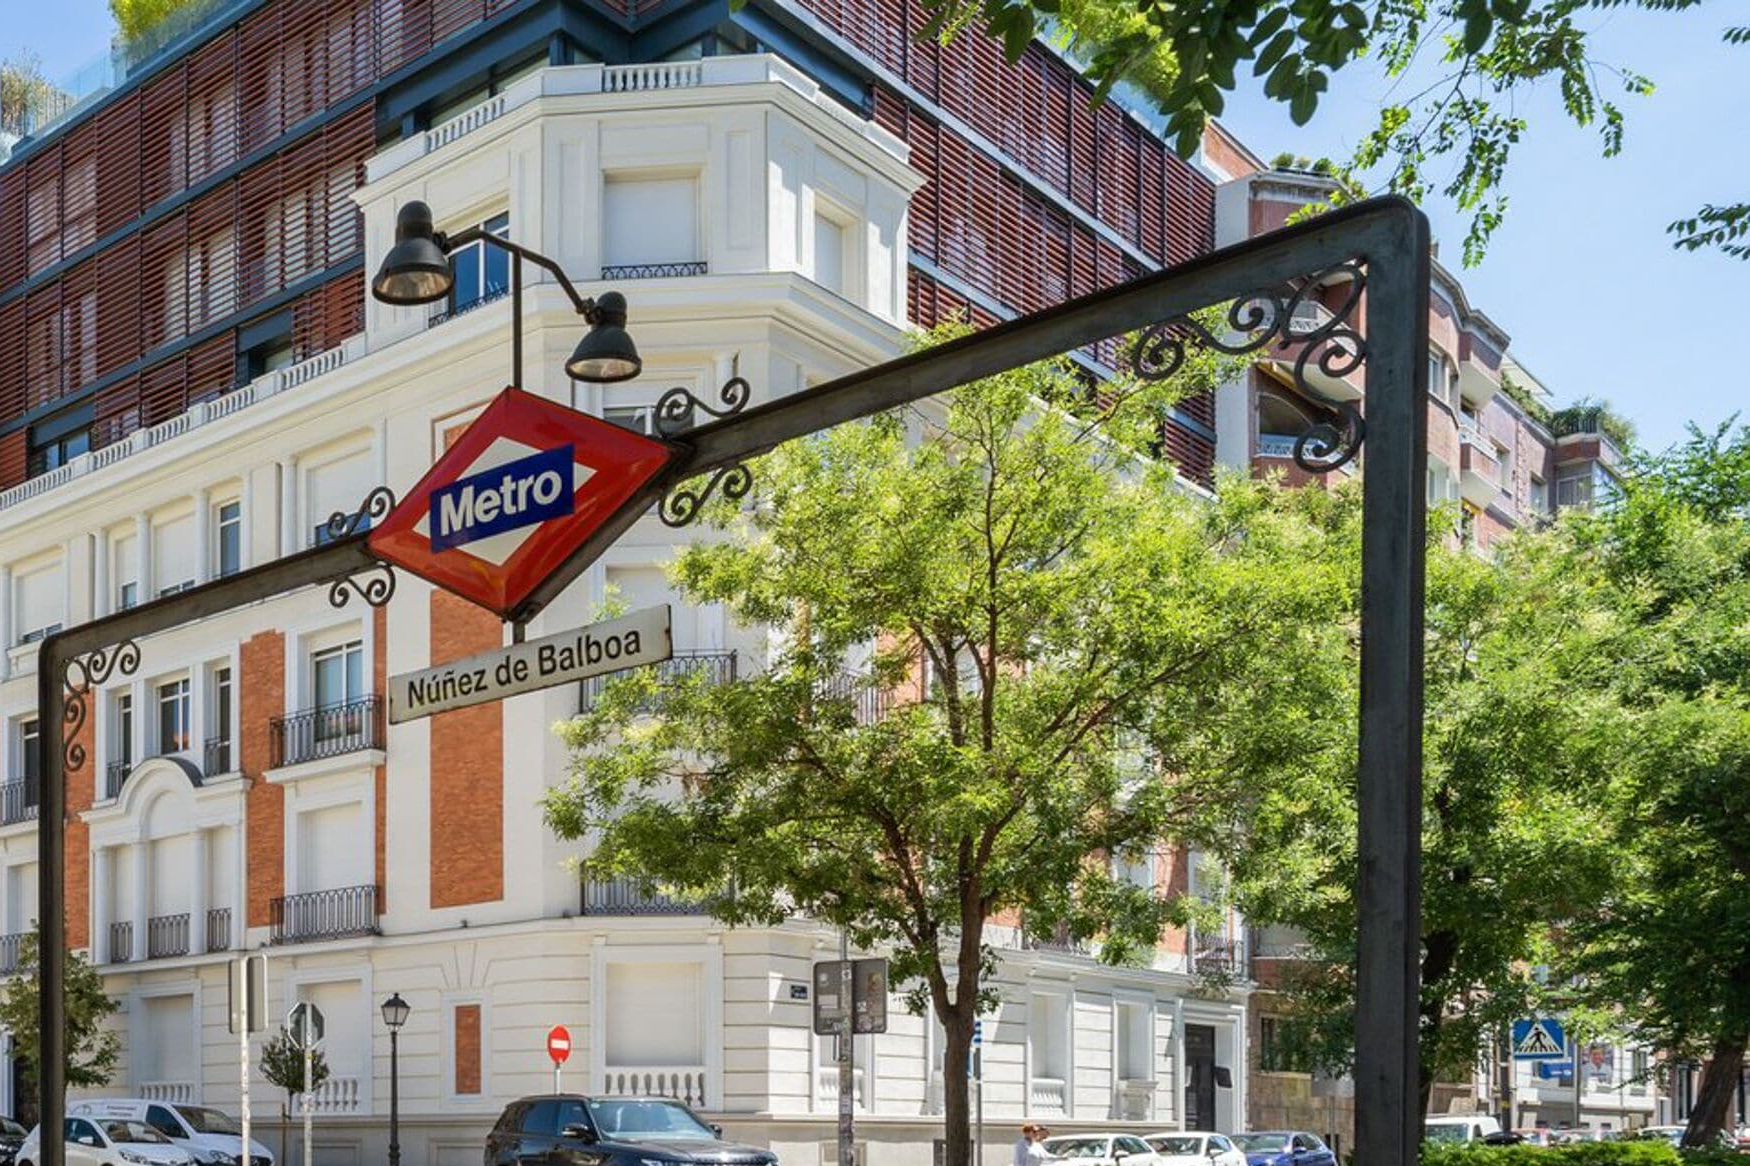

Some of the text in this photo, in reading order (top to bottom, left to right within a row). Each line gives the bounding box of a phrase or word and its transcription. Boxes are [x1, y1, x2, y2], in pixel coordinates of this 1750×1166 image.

[439, 470, 562, 537] Metro
[408, 629, 641, 709] Núñez de Balboa
